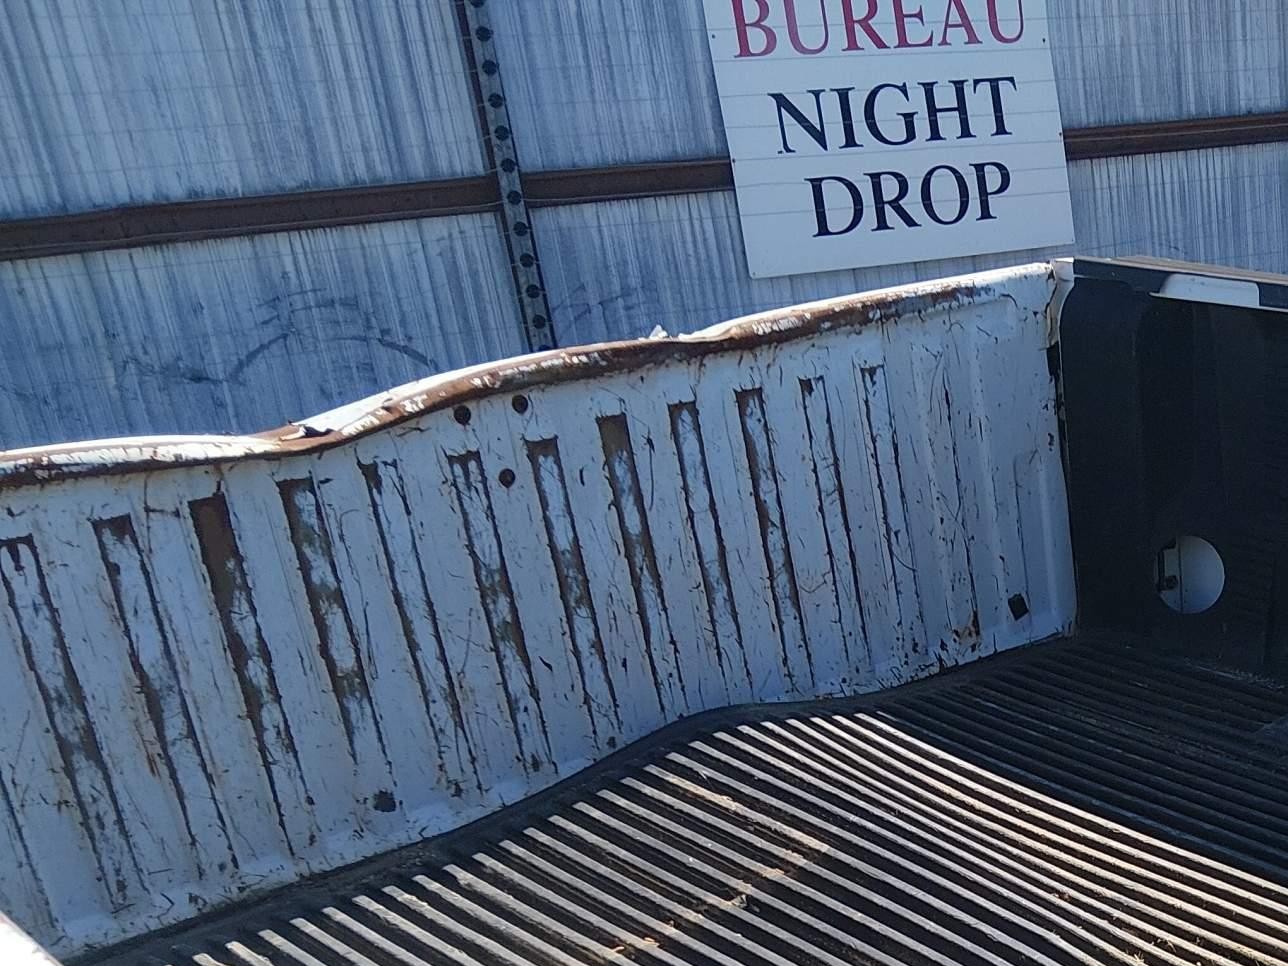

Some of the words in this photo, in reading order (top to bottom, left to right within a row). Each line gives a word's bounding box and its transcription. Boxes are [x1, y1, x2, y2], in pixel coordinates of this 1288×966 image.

[731, 0, 1024, 58] BUREAU
[767, 76, 1017, 154] NIGHT
[804, 162, 1011, 238] DROP
